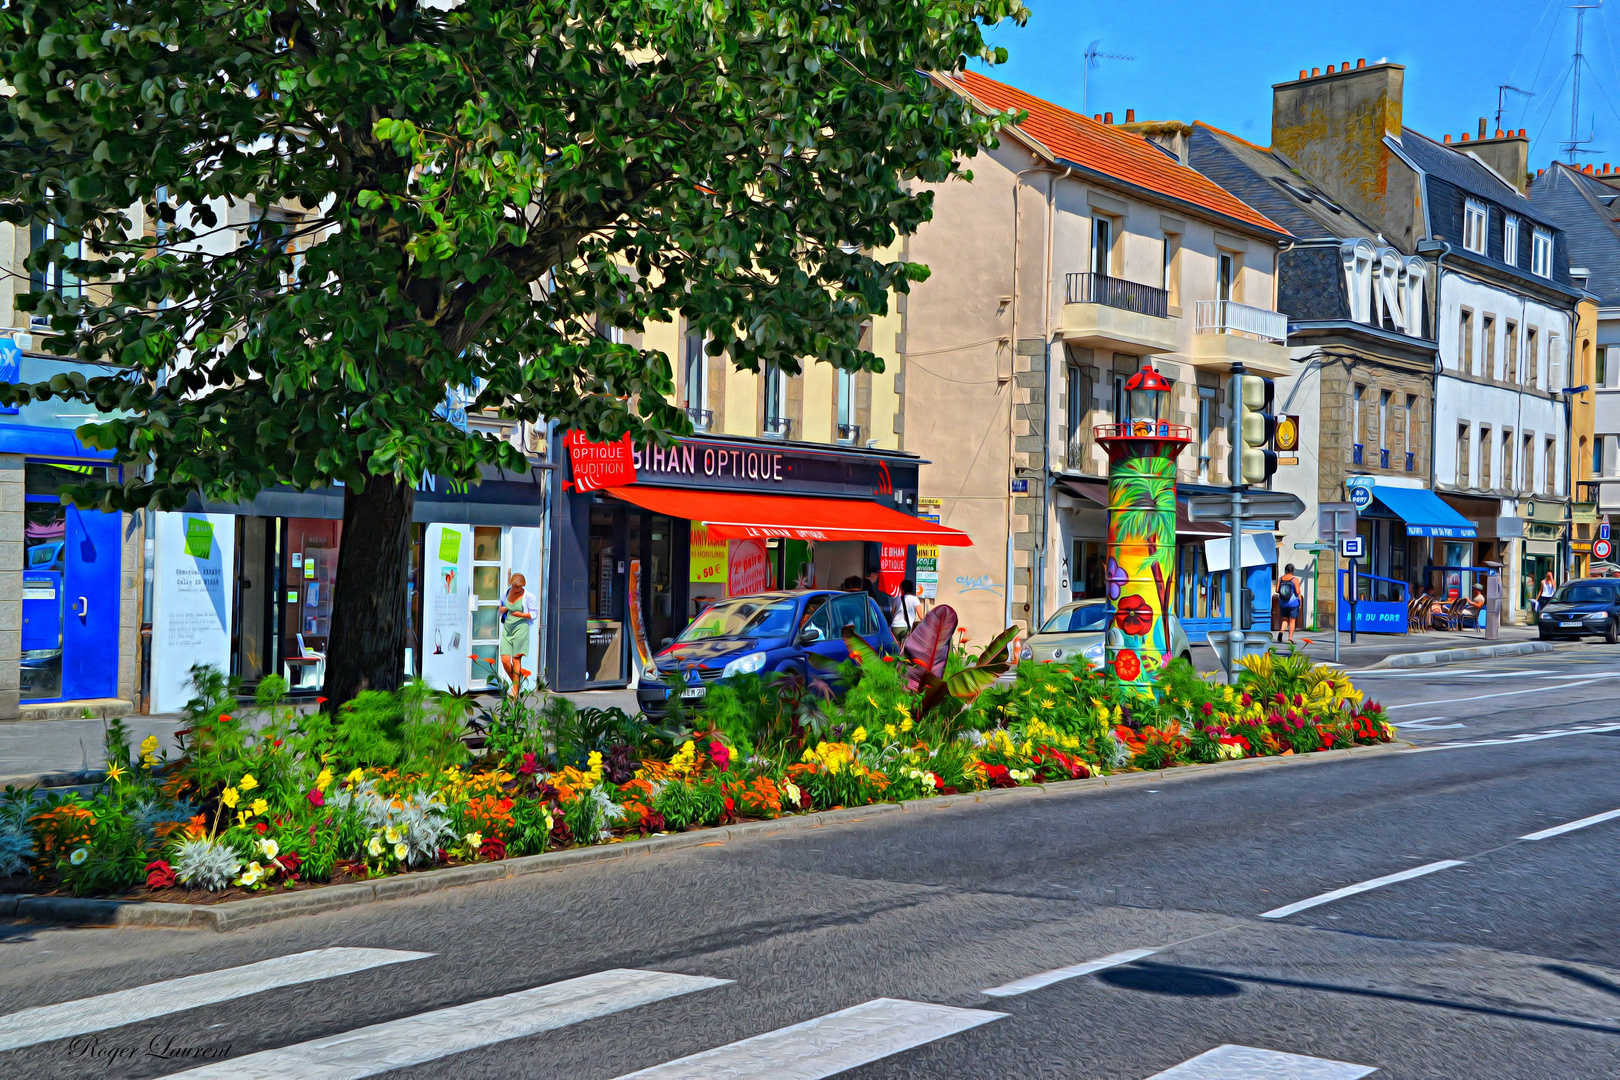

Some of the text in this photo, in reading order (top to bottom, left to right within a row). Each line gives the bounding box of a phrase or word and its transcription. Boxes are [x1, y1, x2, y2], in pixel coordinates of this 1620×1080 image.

[573, 434, 587, 445] LE
[573, 447, 625, 459] OPTIQUE
[574, 462, 624, 475] AUDITION
[704, 449, 783, 481] OPTIQUE
[881, 547, 905, 557] LE BIHAN
[743, 554, 762, 572] paire
[880, 560, 904, 570] OPTIQUE
[703, 566, 714, 578] 50
[1346, 613, 1400, 622] BR DU PORT
